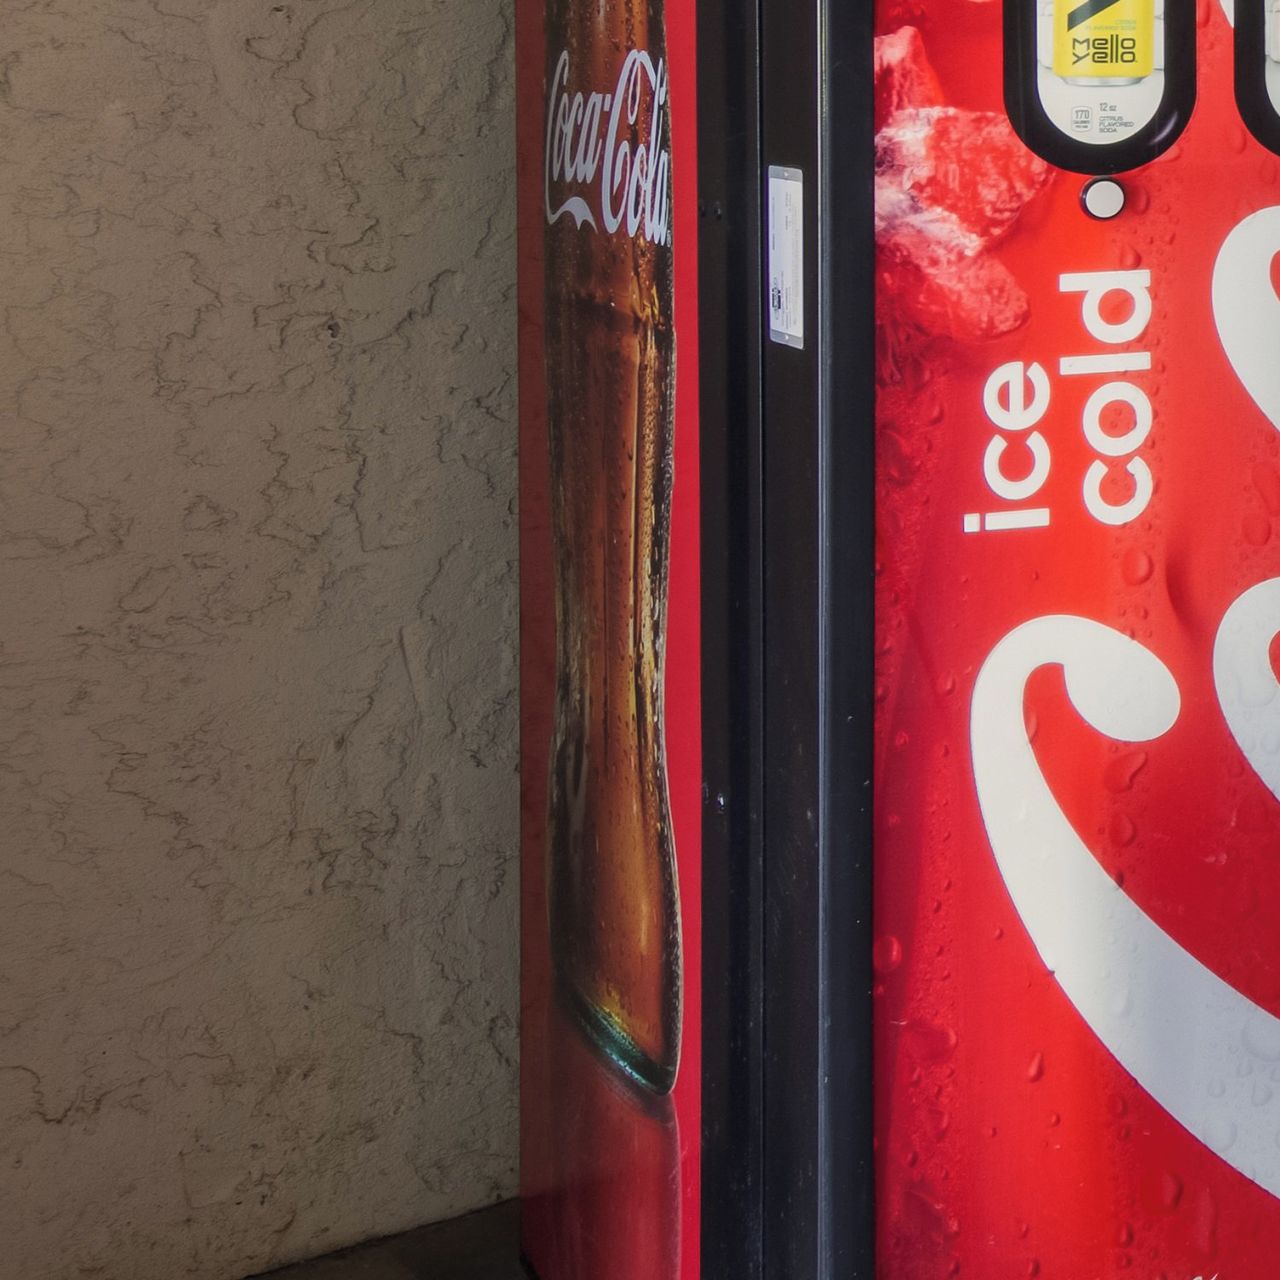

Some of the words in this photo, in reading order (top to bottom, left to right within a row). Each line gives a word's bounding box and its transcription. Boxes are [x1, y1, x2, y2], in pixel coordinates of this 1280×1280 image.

[545, 50, 670, 248] Coca-Cola
[1100, 103, 1107, 111] 12
[964, 361, 1050, 532] ice
[1058, 269, 1153, 525] cold
